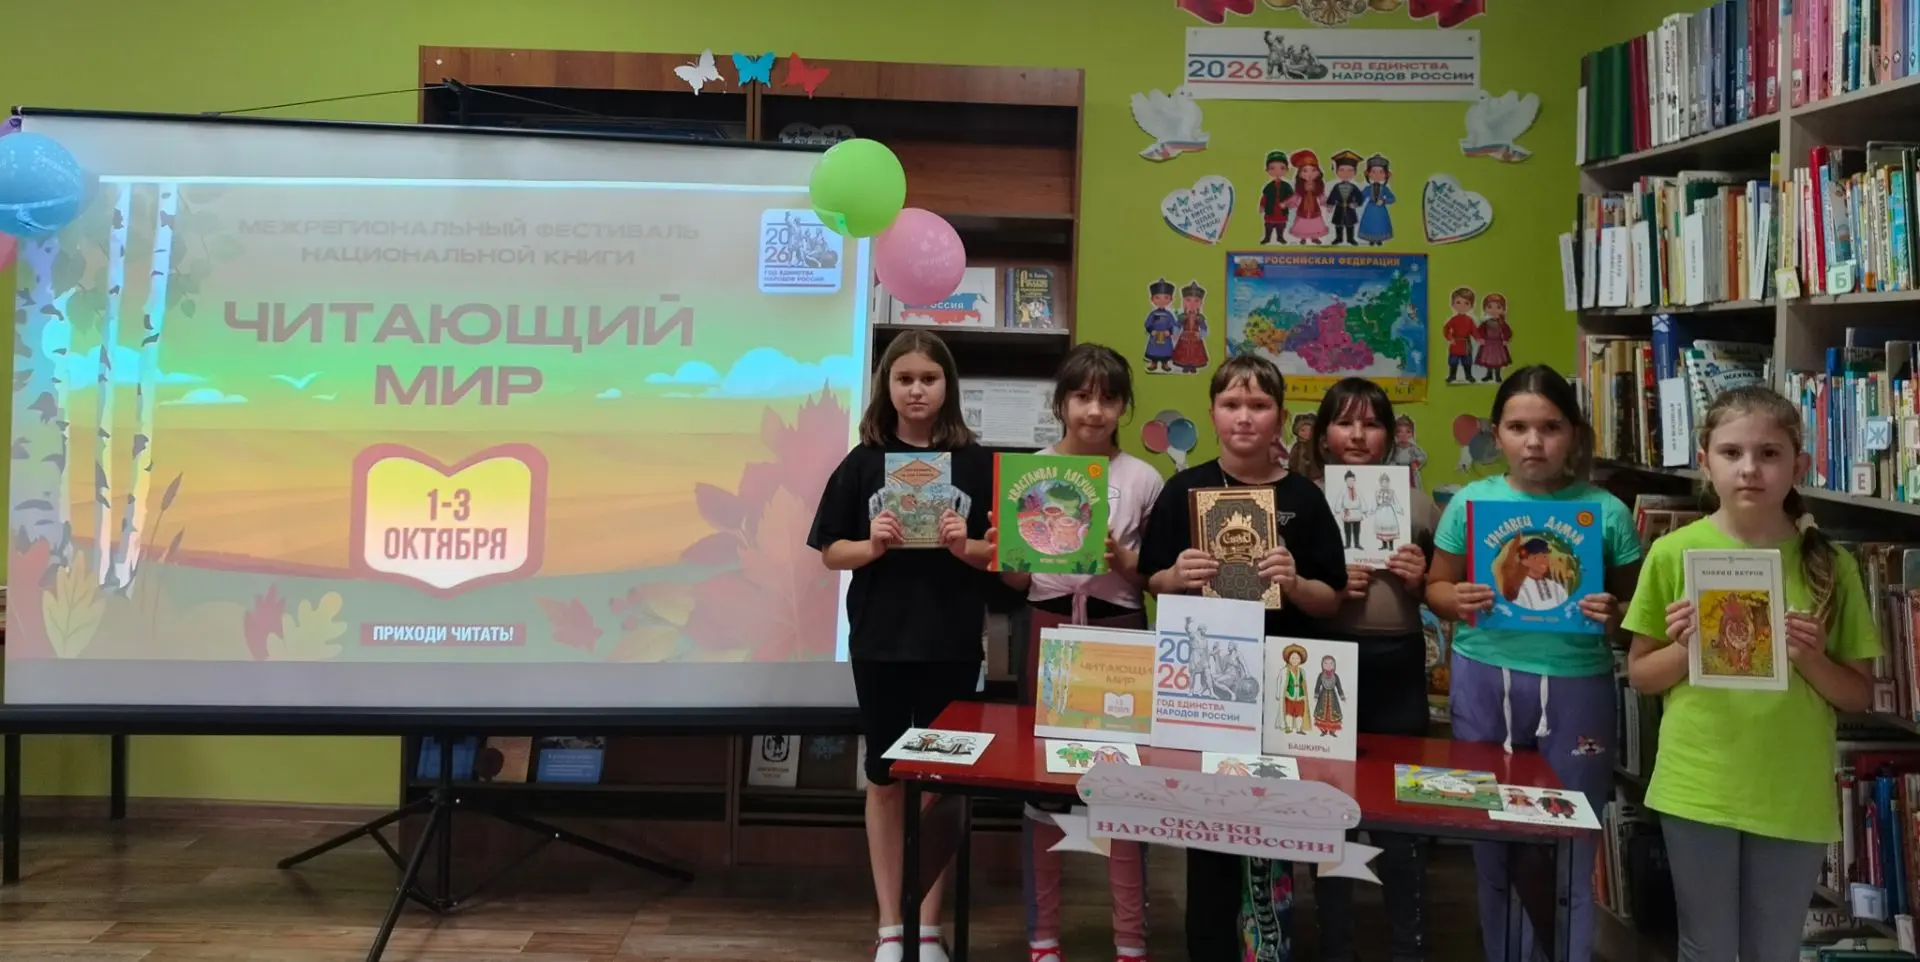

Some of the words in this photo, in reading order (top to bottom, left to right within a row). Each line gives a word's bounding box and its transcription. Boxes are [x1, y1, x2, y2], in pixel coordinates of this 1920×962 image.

[1188, 60, 1263, 79] 2026
[1332, 62, 1363, 70] ГОД
[1368, 62, 1449, 70] ЕДИНСТВА
[1332, 72, 1406, 80] НАРОДОВ
[1411, 72, 1474, 80] РОССИИ
[238, 217, 527, 238] МЕЖРЕГИОНАЛЬНЫЙ
[536, 221, 699, 240] ФЕСТИВАЛЬ
[765, 228, 790, 245] 20
[301, 246, 536, 266] НАЦИОНАЛЬНОЙ
[543, 248, 635, 266] КНИГИ
[764, 246, 790, 263] 26
[1264, 256, 1335, 265] РОССИЙСКАЯ
[1784, 279, 1795, 294] А
[1835, 272, 1847, 290] Б
[223, 294, 694, 353] ЧИТАЮЩИЙ
[374, 365, 543, 406] МИР
[1868, 426, 1886, 445] Ж
[1858, 472, 1866, 491] Е
[427, 488, 471, 521] 1-3
[384, 527, 508, 560] ОКТЯБРЯ
[373, 625, 447, 643] ПРИХОДИ
[451, 625, 513, 642] ЧИТАТЬ!
[1159, 638, 1191, 664] 20
[1080, 661, 1153, 676] ЧИТАЮЩИ
[1158, 664, 1191, 690] 26
[1105, 675, 1136, 687] МИР
[1156, 708, 1200, 718] НАРОДОВ
[1202, 711, 1240, 721] РОССИИ
[1157, 699, 1175, 708] ГОД
[1178, 700, 1225, 711] ЕДИНСТВА
[1288, 743, 1330, 753] БАШКИРЫ
[1160, 816, 1262, 836] СКАЗКИ
[1096, 821, 1220, 842] НАРОДОВ
[1227, 834, 1335, 854] РОССИИ
[1862, 895, 1877, 915] Т
